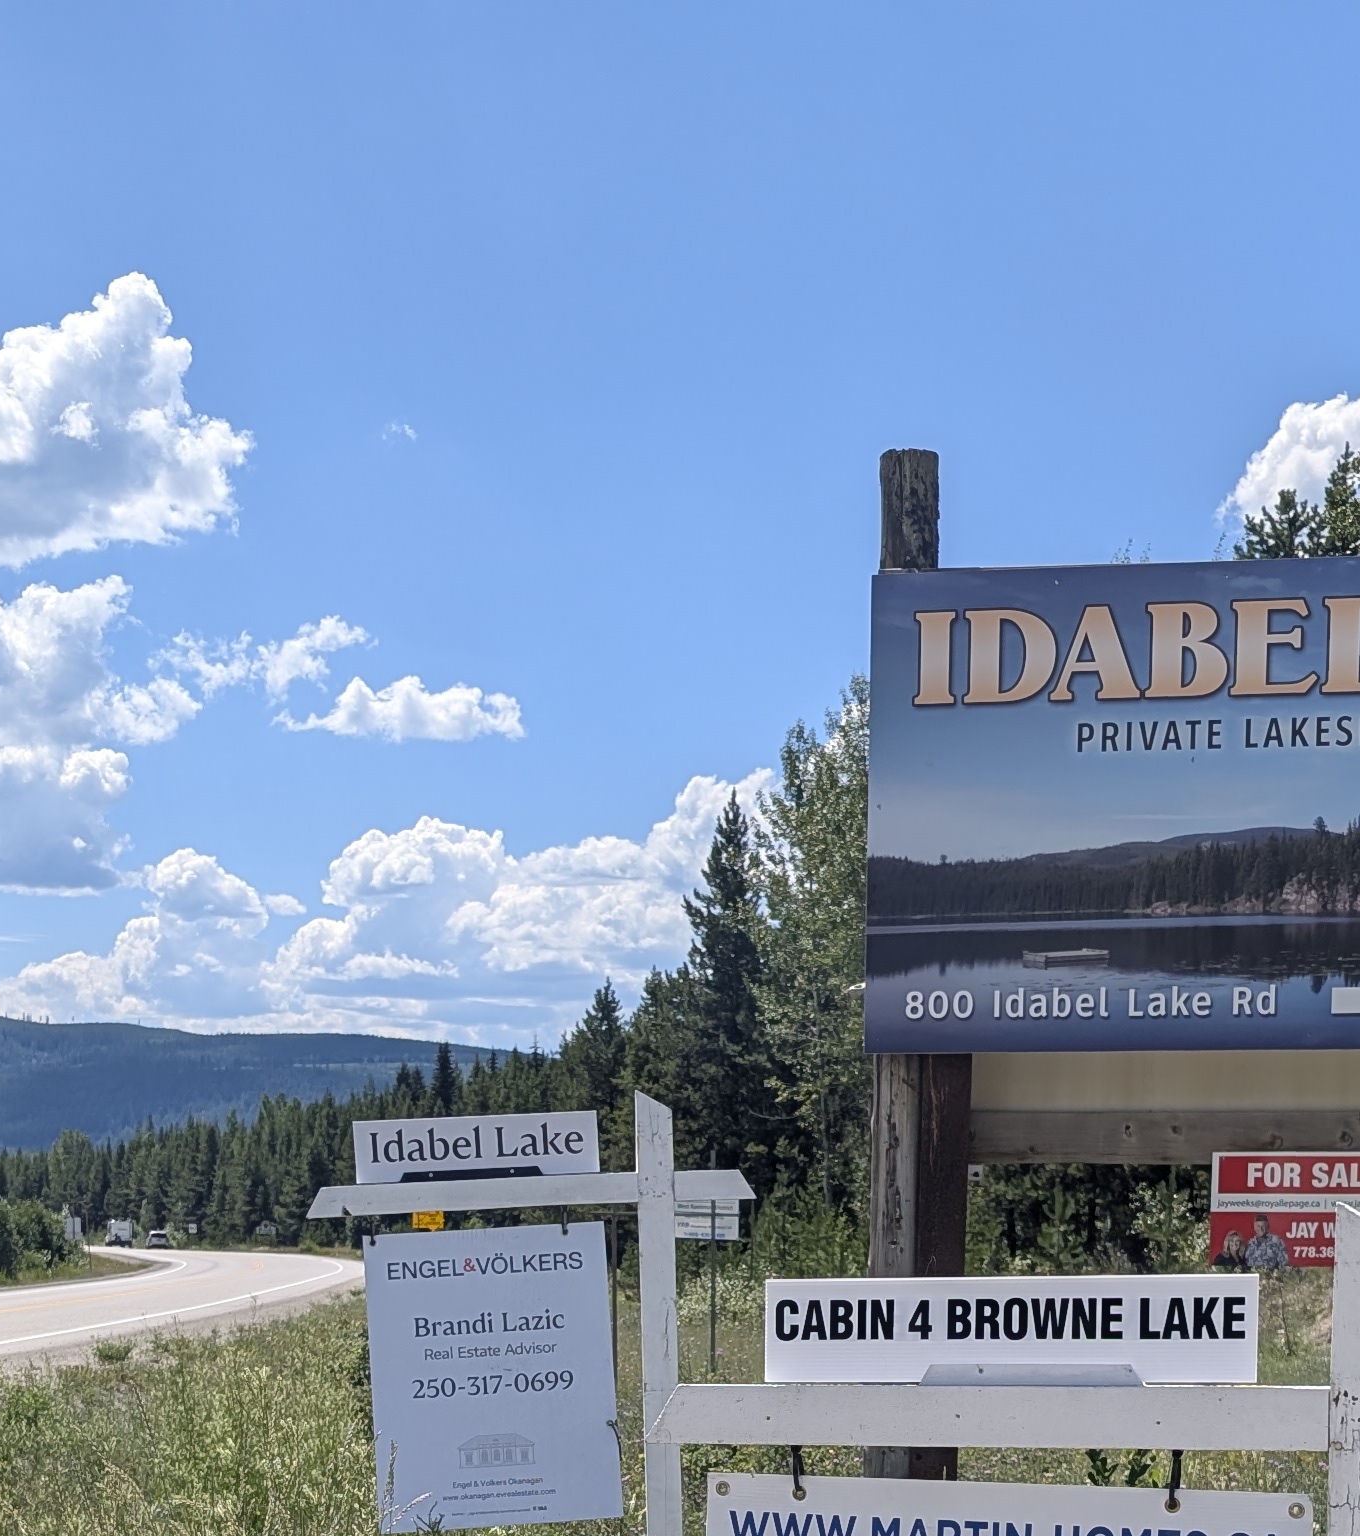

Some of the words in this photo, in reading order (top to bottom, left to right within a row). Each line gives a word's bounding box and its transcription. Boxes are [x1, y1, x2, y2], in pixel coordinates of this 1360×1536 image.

[1077, 718, 1224, 754] PRIVATE
[904, 990, 975, 1020] 800
[993, 987, 1109, 1018] Idabel
[1128, 985, 1212, 1017] Lake
[1231, 984, 1277, 1016] Rd
[369, 1124, 484, 1163] Idabel
[494, 1121, 584, 1158] Lake
[1246, 1161, 1301, 1188] FOR
[1285, 1222, 1319, 1239] JAY
[387, 1251, 584, 1281] ENGEL&VÖLKERS
[413, 1311, 494, 1338] Brandi
[501, 1308, 566, 1333] Lazic
[775, 1298, 894, 1342] CABIN
[908, 1298, 932, 1341] 4
[947, 1296, 1124, 1341] BROWNE
[1138, 1296, 1247, 1341] LAKE
[424, 1346, 454, 1361] Real
[458, 1344, 501, 1359] Estate
[504, 1341, 558, 1356] Advisor
[411, 1369, 574, 1399] 250-317-0699
[452, 1480, 473, 1489] Engel
[473, 1480, 480, 1488] &
[507, 1477, 544, 1486] Okanagan
